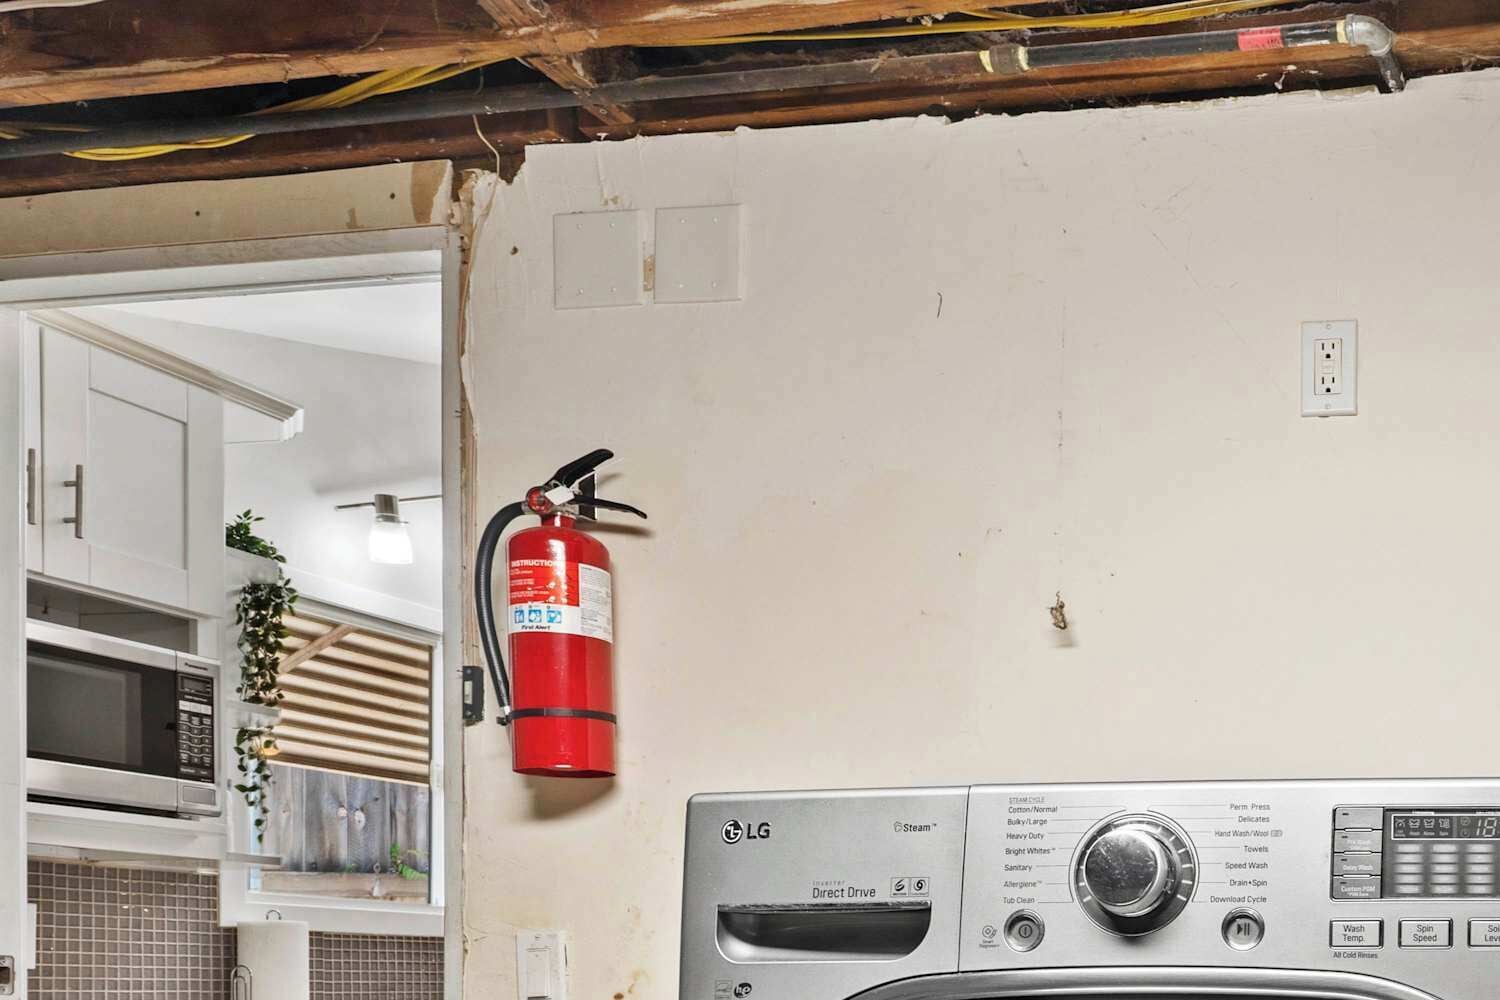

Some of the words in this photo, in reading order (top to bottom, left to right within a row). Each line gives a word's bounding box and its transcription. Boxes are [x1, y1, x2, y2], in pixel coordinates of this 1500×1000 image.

[1008, 806, 1058, 814] Cotton/Normal
[1007, 818, 1048, 826] Bulky/Large
[746, 822, 770, 840] LG
[903, 823, 931, 832] Steam
[1006, 832, 1027, 840] Heavy
[1028, 832, 1044, 840] Duty
[1005, 848, 1026, 856] Bright
[1004, 864, 1032, 872] Sanitary
[1225, 862, 1247, 870] Speed
[812, 887, 845, 898] Direct
[848, 886, 876, 898] Drive
[1004, 896, 1015, 904] Tub
[1016, 896, 1035, 904] Clean
[1210, 895, 1246, 903] Download
[1247, 895, 1267, 904] Cycle
[1343, 924, 1365, 933] Wash
[1416, 924, 1434, 934] Spin
[1342, 934, 1365, 942] Temp.
[1413, 934, 1438, 944] Speed
